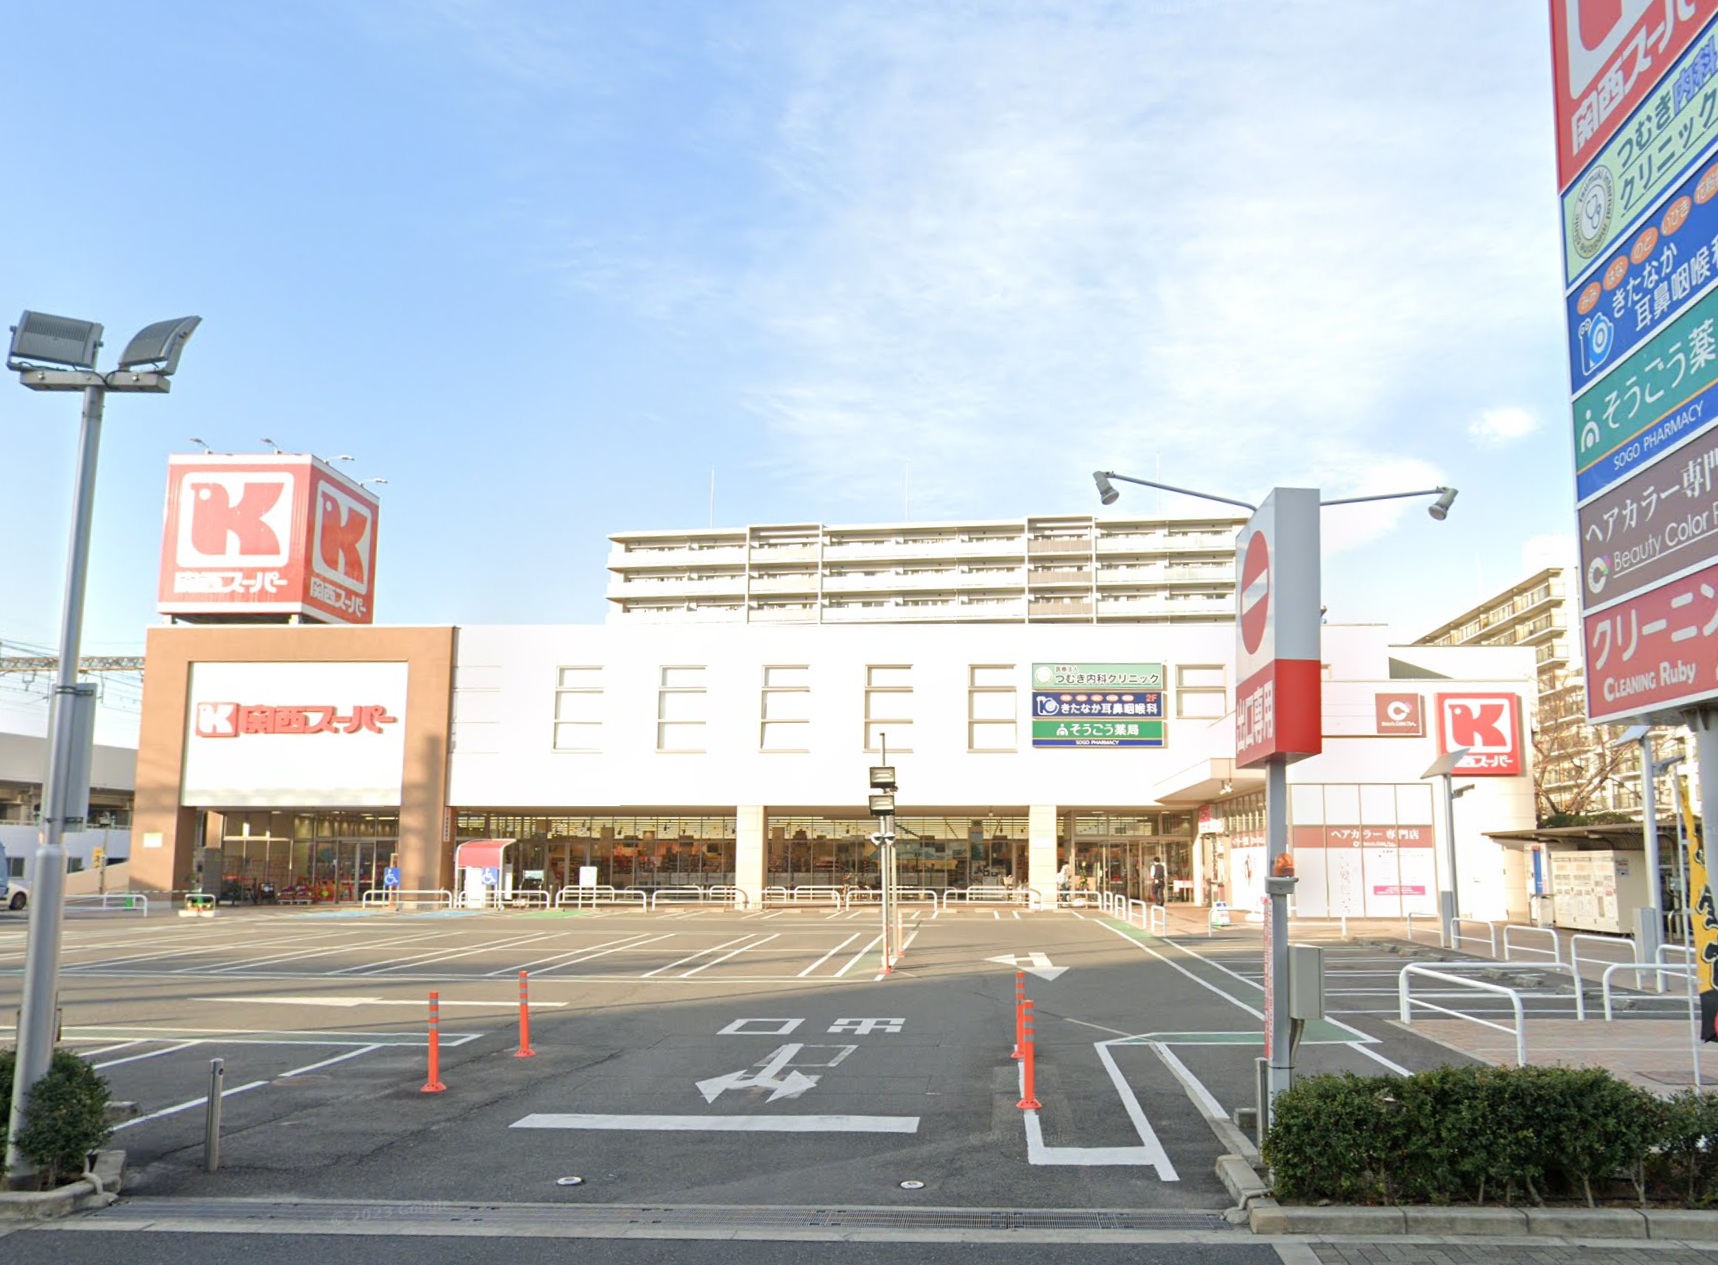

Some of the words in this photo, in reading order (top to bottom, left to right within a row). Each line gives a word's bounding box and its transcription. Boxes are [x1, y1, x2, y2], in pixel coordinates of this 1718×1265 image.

[1620, 88, 1718, 210] クリニック
[1608, 261, 1625, 286] はな
[1612, 242, 1678, 318] きたなか
[1613, 443, 1641, 471] SOGO
[1643, 400, 1704, 452] PHARMACY
[1613, 534, 1662, 572] Beauty
[1665, 511, 1709, 547] Color
[310, 576, 367, 619] 関西スーパー
[1659, 660, 1696, 686] Ruby
[240, 704, 397, 735] 関西スーパー
[1061, 703, 1158, 714] きたなか耳鼻咽喉科
[1146, 694, 1158, 702] 2F
[1237, 681, 1273, 755] 出口専用
